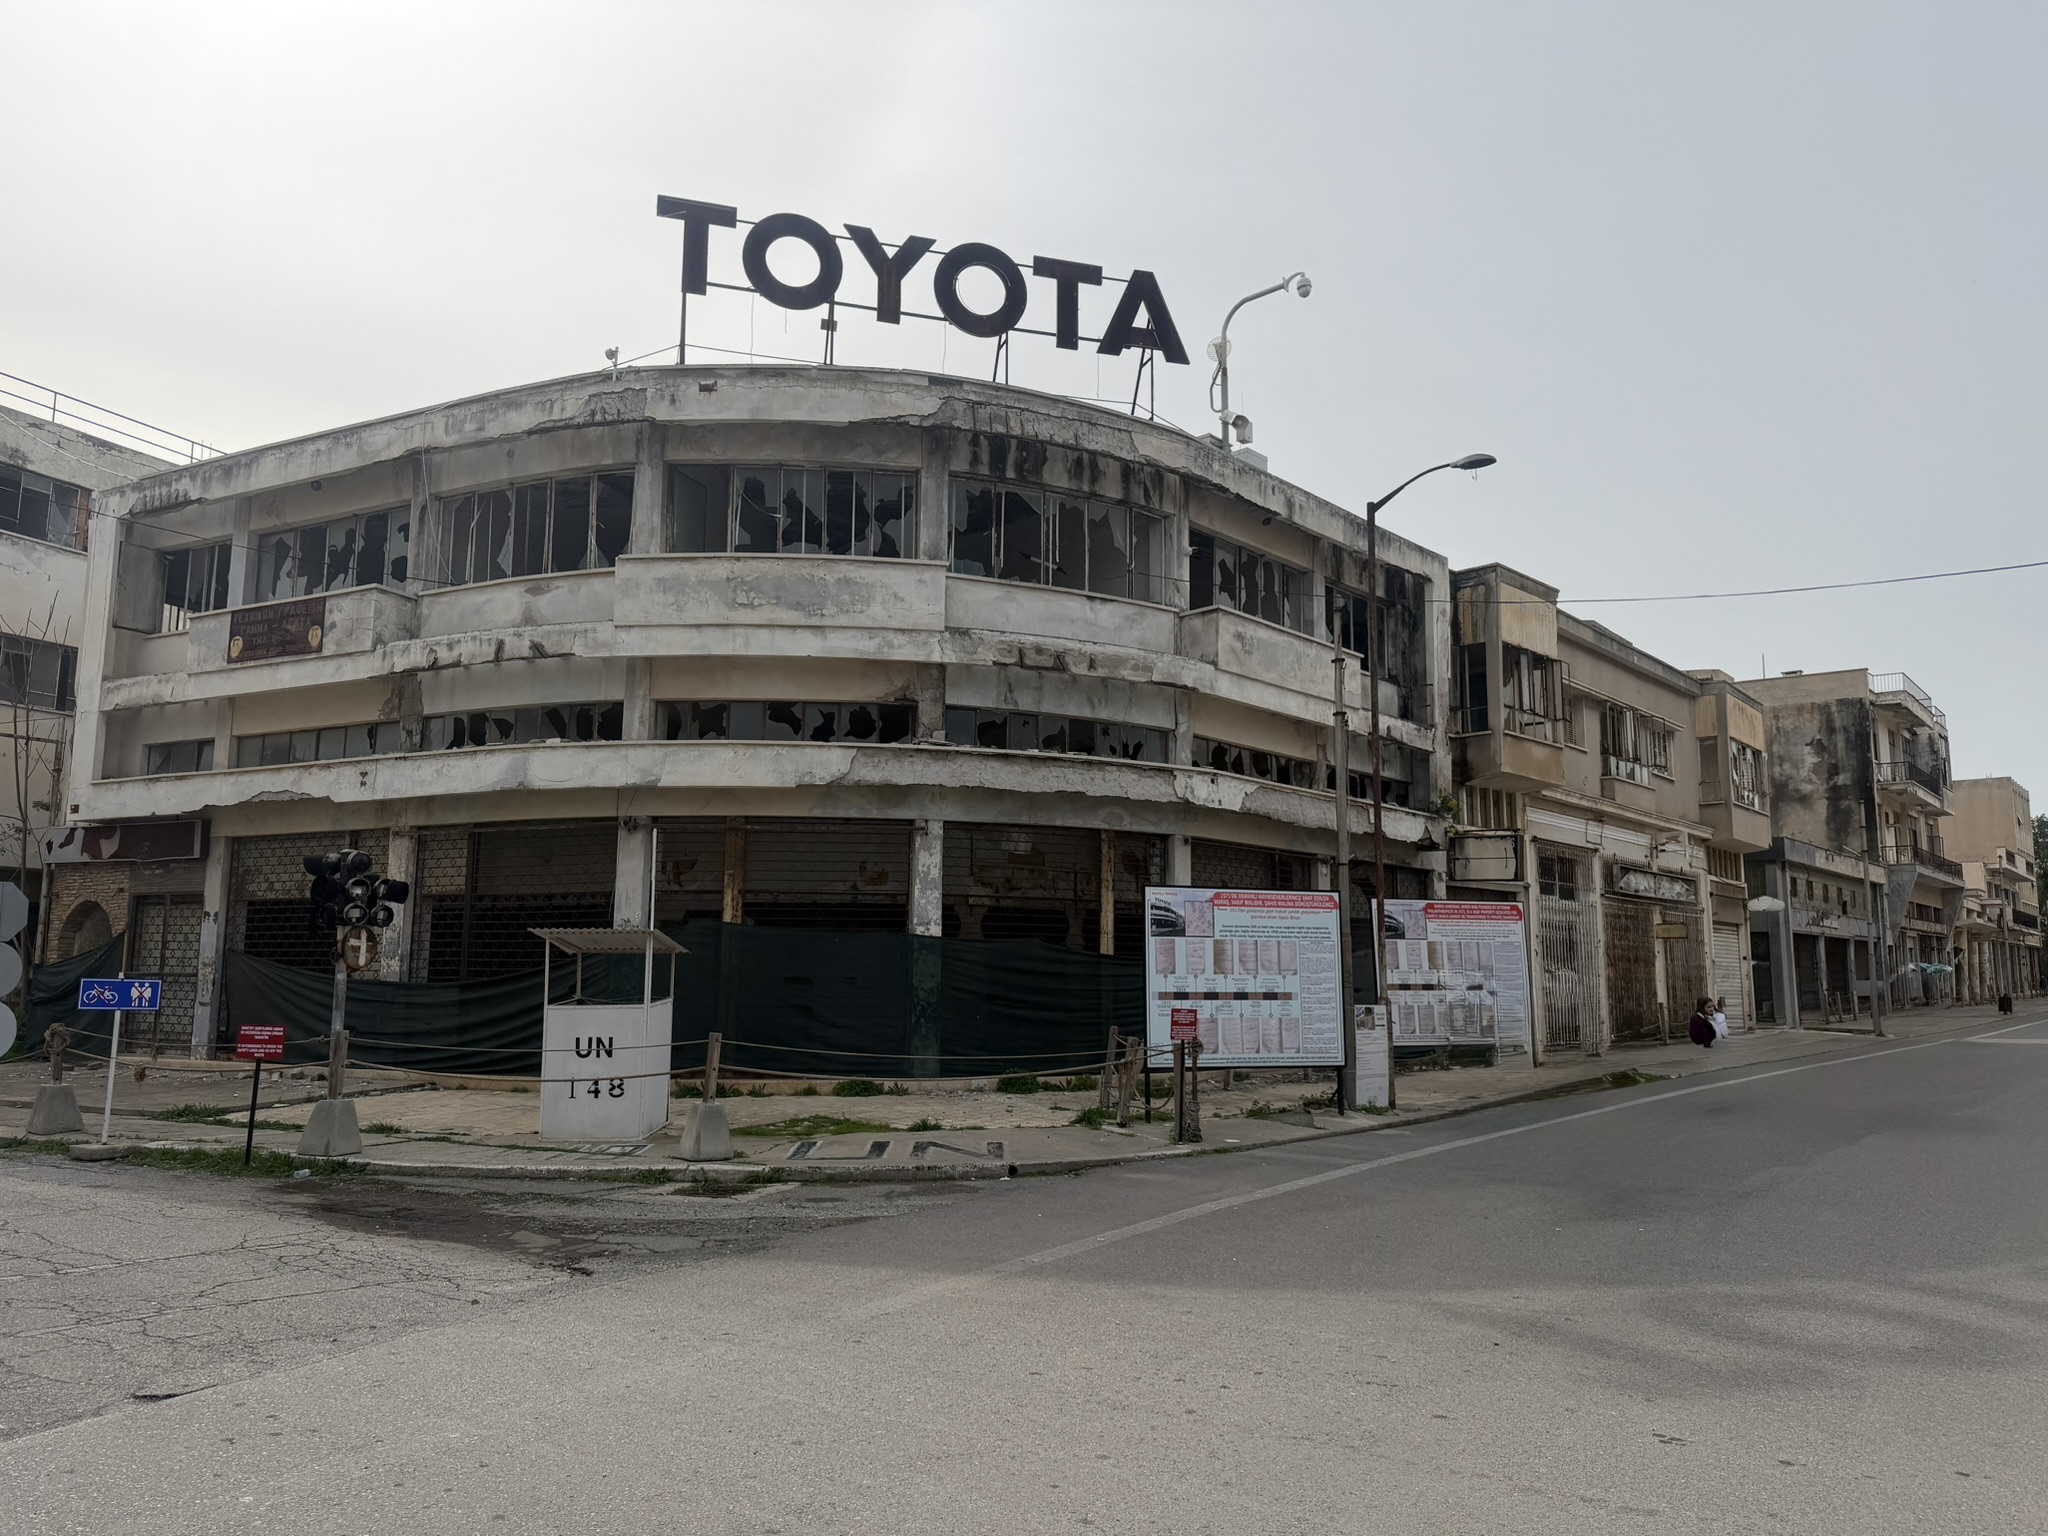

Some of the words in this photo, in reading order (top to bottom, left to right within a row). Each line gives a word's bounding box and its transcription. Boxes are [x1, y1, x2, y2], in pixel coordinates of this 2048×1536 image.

[657, 194, 1190, 364] TOYOTA
[575, 1036, 614, 1058] UN
[568, 1077, 624, 1099] 148
